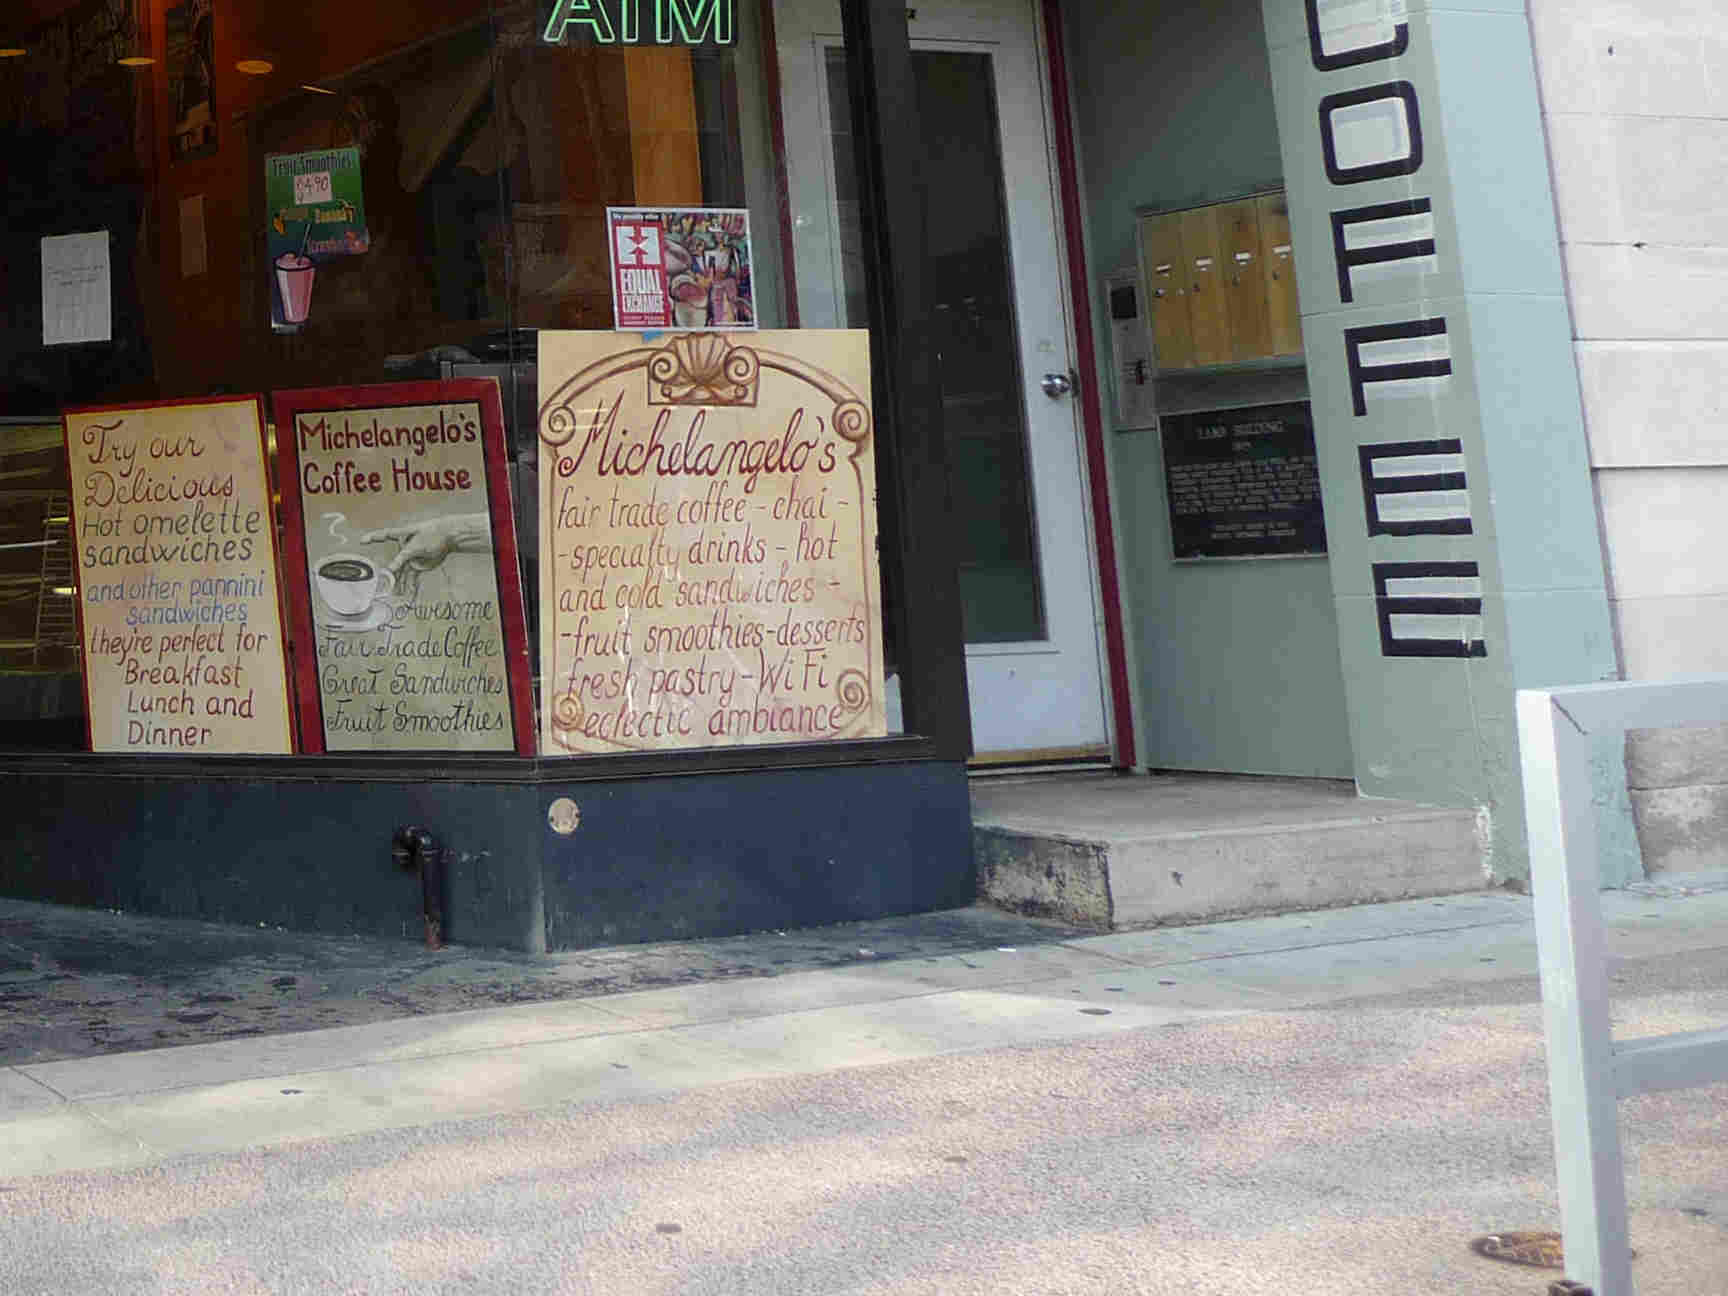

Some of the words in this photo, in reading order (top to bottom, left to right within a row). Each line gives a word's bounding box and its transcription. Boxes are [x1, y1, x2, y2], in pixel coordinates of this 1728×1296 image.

[620, 269, 661, 294] EQUAL
[623, 294, 665, 313] EXCHANGE
[82, 419, 137, 477] Try
[150, 432, 205, 458] our
[298, 411, 476, 456] Michelangelo's
[557, 390, 837, 494] Michelangelo's
[84, 467, 234, 508] Delicious
[303, 461, 382, 494] Coffee
[391, 457, 472, 493] House
[82, 510, 123, 537] Hot
[133, 499, 263, 536] omelette
[557, 485, 601, 529] fair
[608, 483, 669, 529] trade
[676, 480, 746, 524] coffee
[772, 475, 829, 520] chai
[83, 535, 254, 568] sandwiches
[688, 523, 767, 566] drinks
[796, 521, 838, 562] hot
[190, 570, 265, 604] pannini
[559, 576, 607, 612] and
[615, 567, 665, 609] cold
[675, 560, 816, 607] sandwiches
[126, 599, 249, 626] sandwiches
[158, 623, 226, 663] perfect
[236, 622, 270, 653] for
[444, 624, 499, 669] Coffee
[124, 654, 245, 688] Breakfast
[322, 663, 385, 696] Great
[389, 661, 504, 696] Sandwiches
[566, 657, 639, 699] fresh
[127, 688, 195, 716] Lunch
[205, 688, 255, 719] and
[326, 698, 390, 732] Fruit
[392, 698, 504, 733] Smoothies
[583, 704, 693, 738] eclectic
[708, 692, 845, 737] ambiance
[127, 719, 213, 746] Dinner
